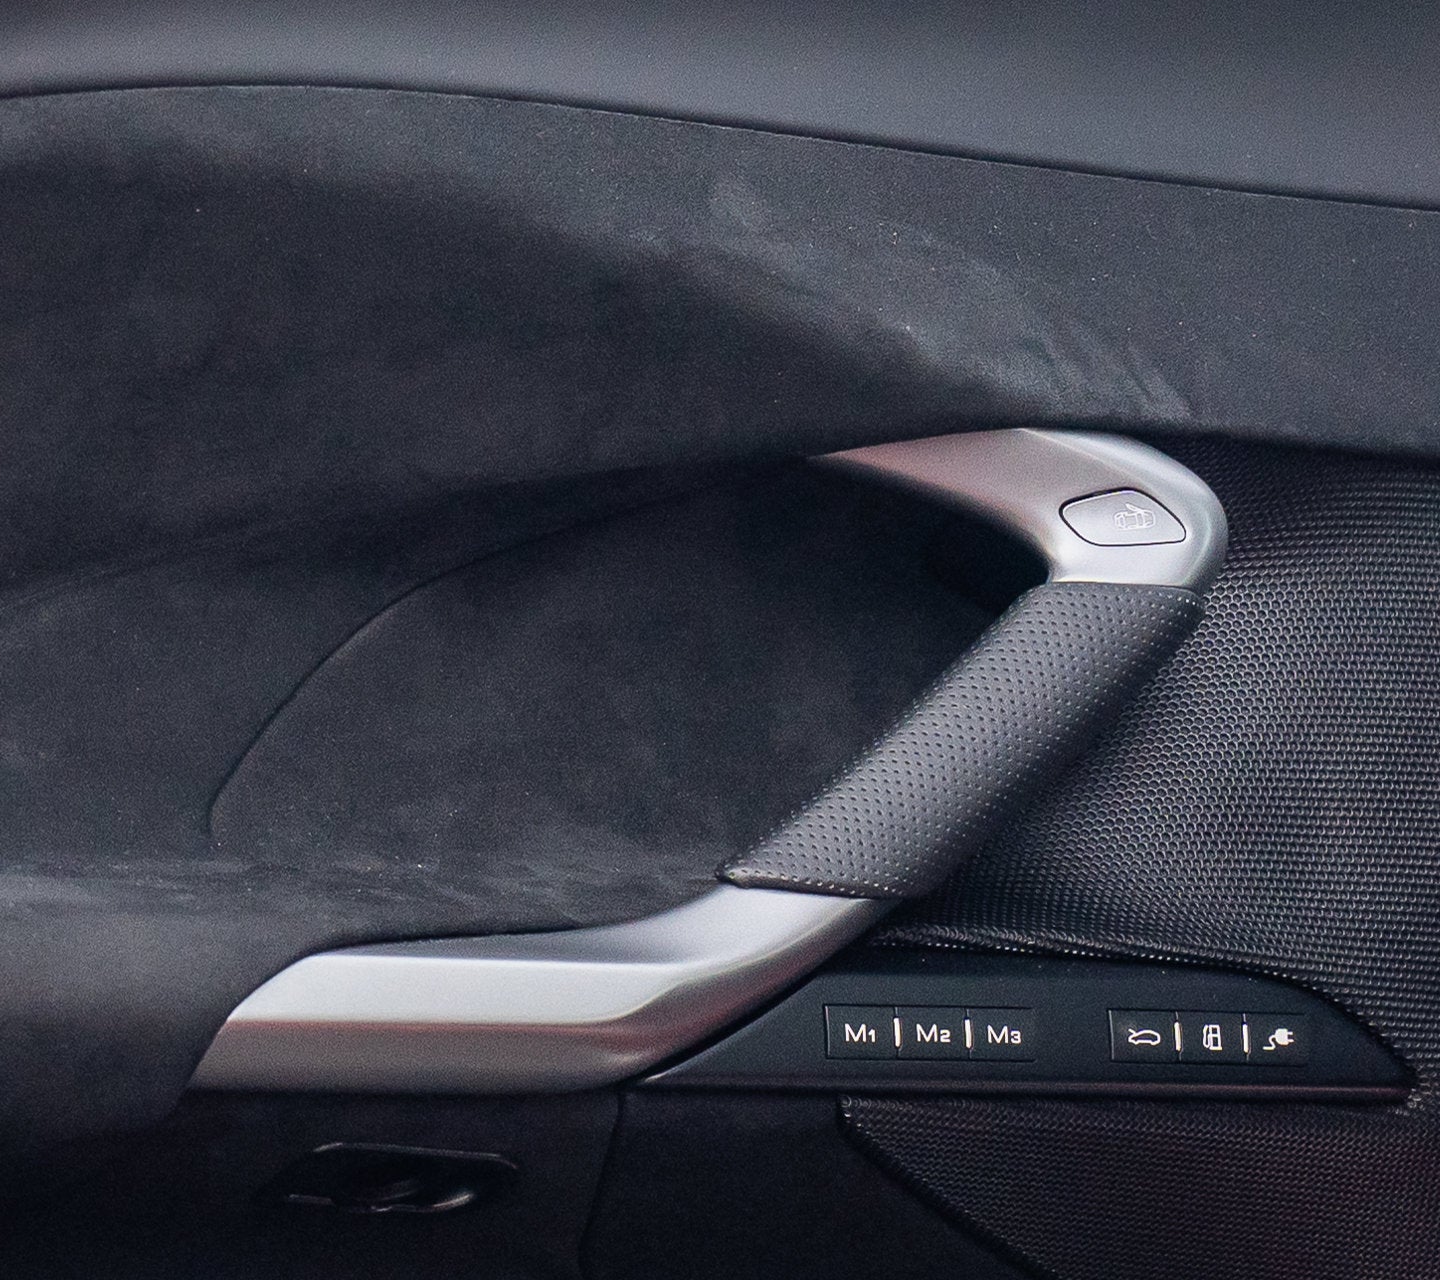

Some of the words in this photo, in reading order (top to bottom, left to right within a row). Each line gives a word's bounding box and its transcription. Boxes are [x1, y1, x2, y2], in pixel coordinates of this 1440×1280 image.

[845, 1023, 877, 1044] M1
[916, 1023, 951, 1044] M2
[987, 1024, 1022, 1045] M3
